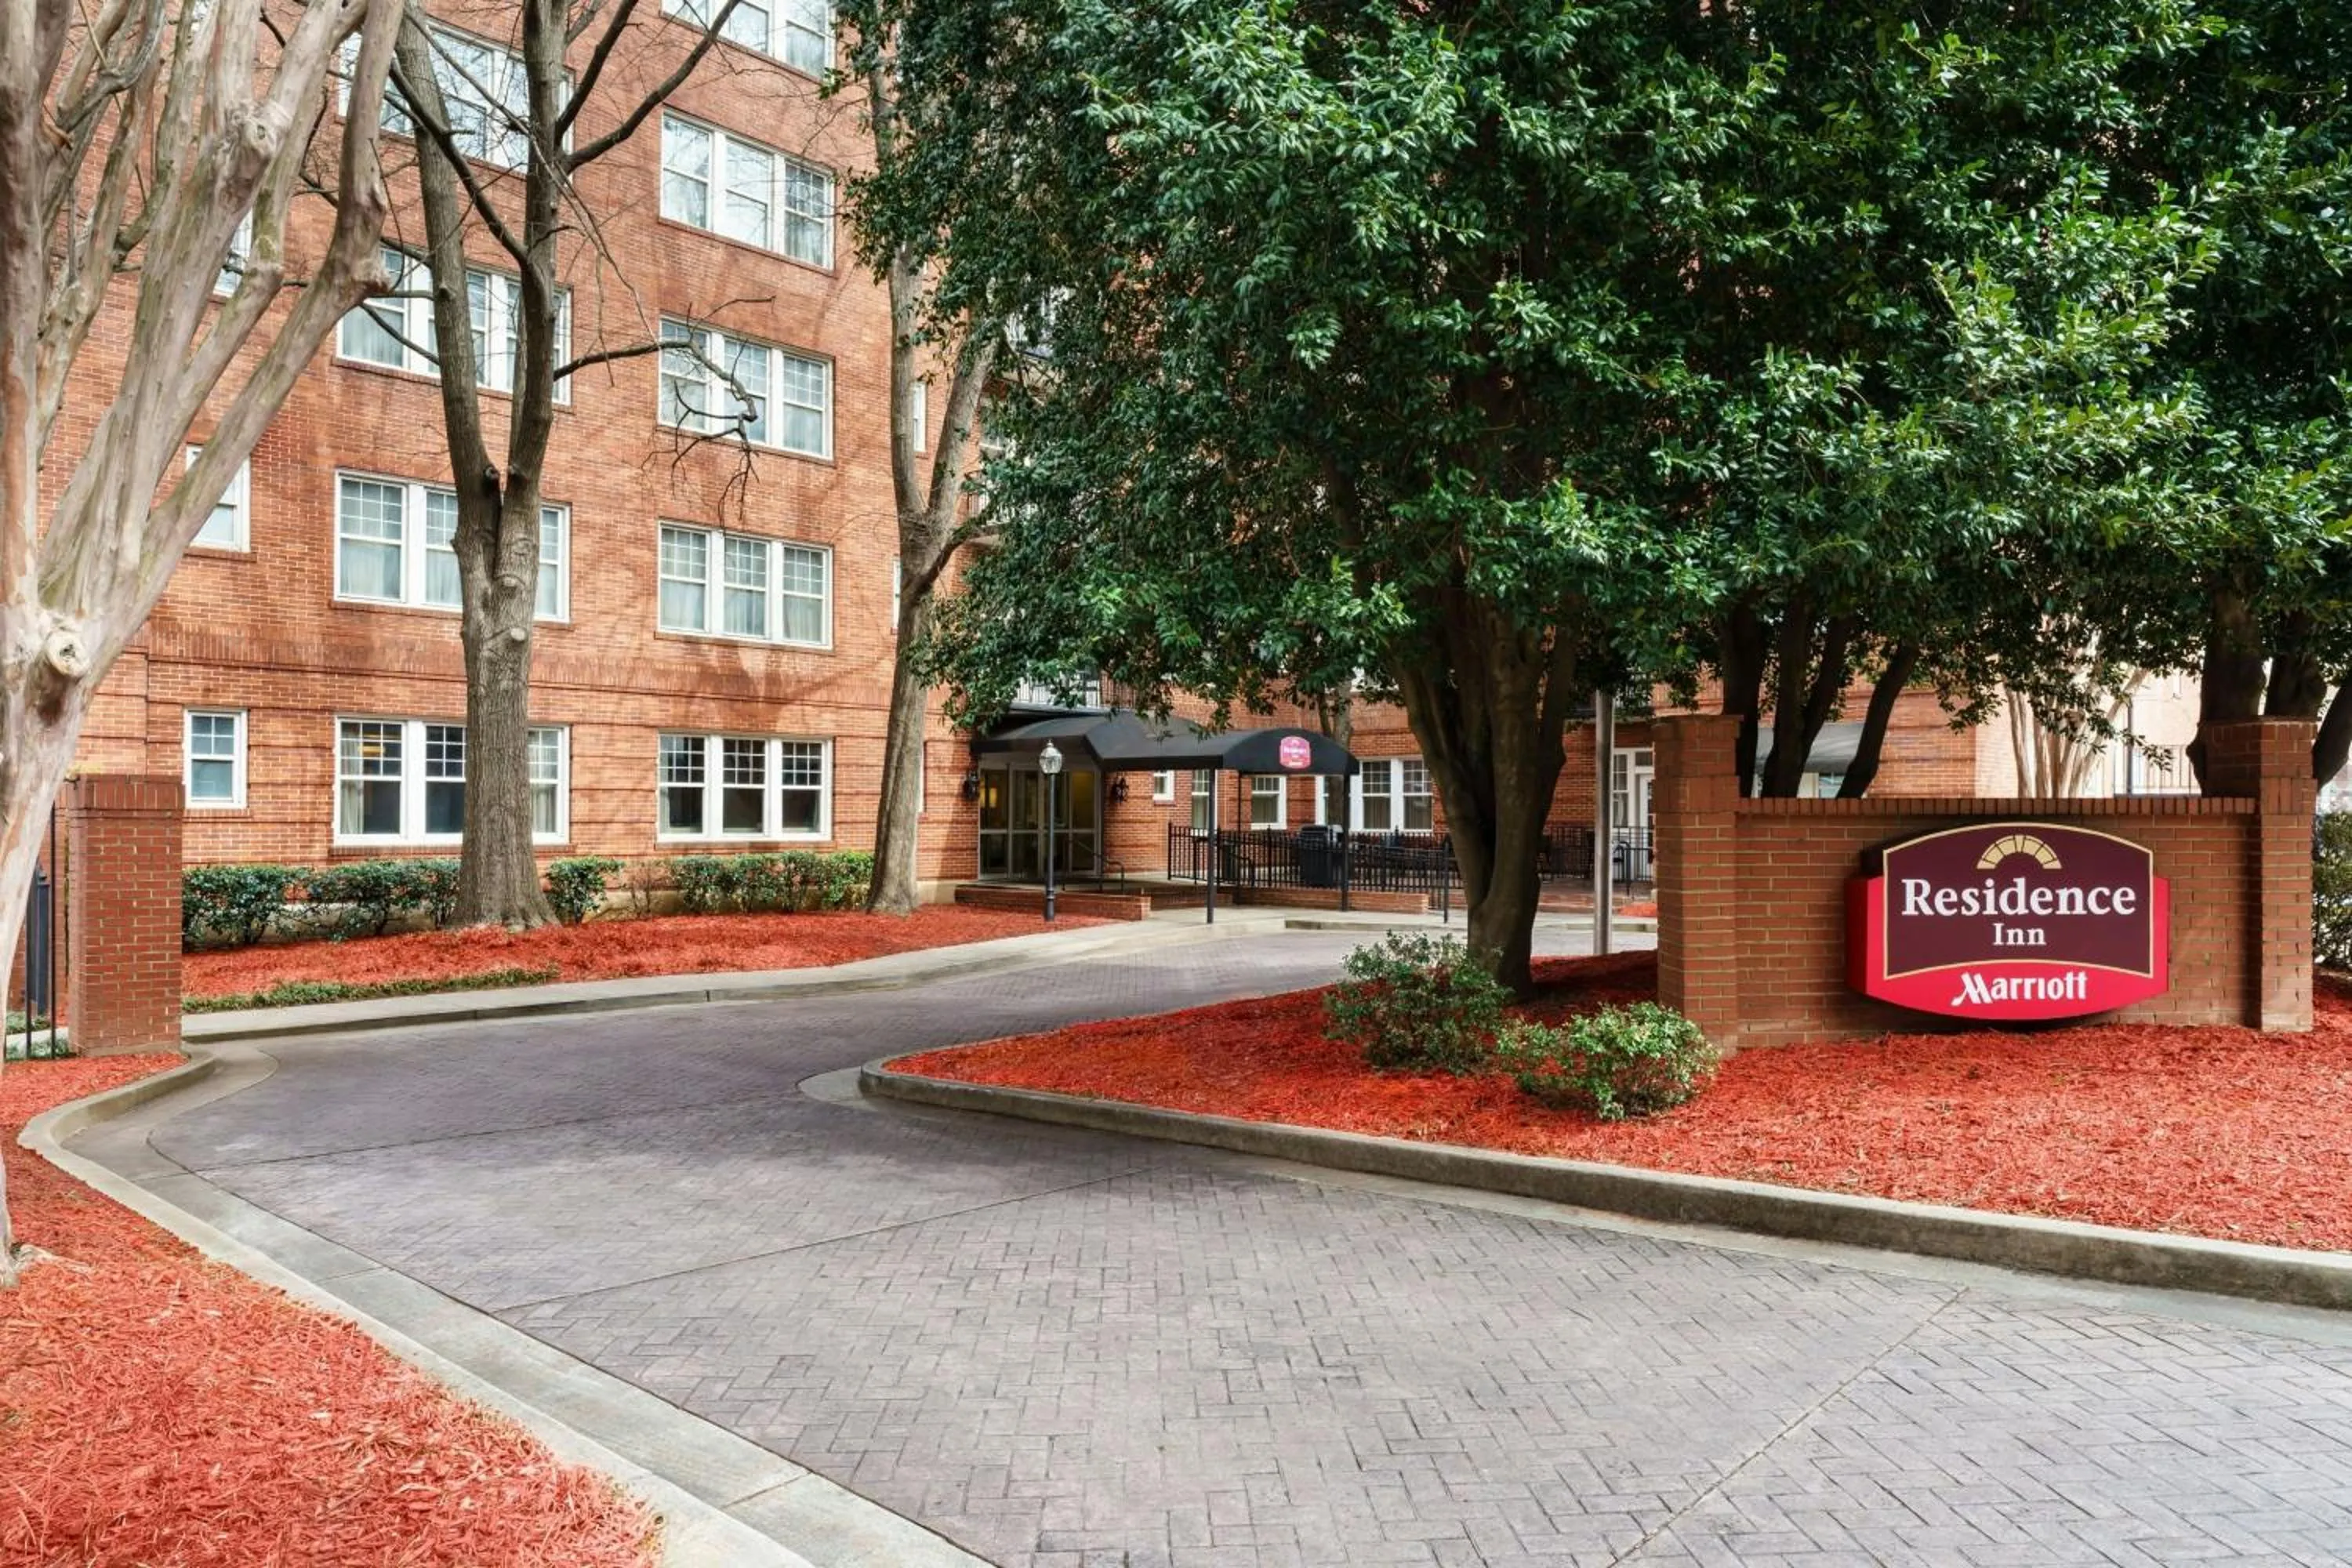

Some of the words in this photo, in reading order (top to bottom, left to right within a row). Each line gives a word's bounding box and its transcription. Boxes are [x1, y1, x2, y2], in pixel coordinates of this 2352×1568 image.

[1901, 877, 2136, 916] Residence
[1992, 923, 2047, 946] Inn
[1951, 971, 2088, 1007] Marriott
